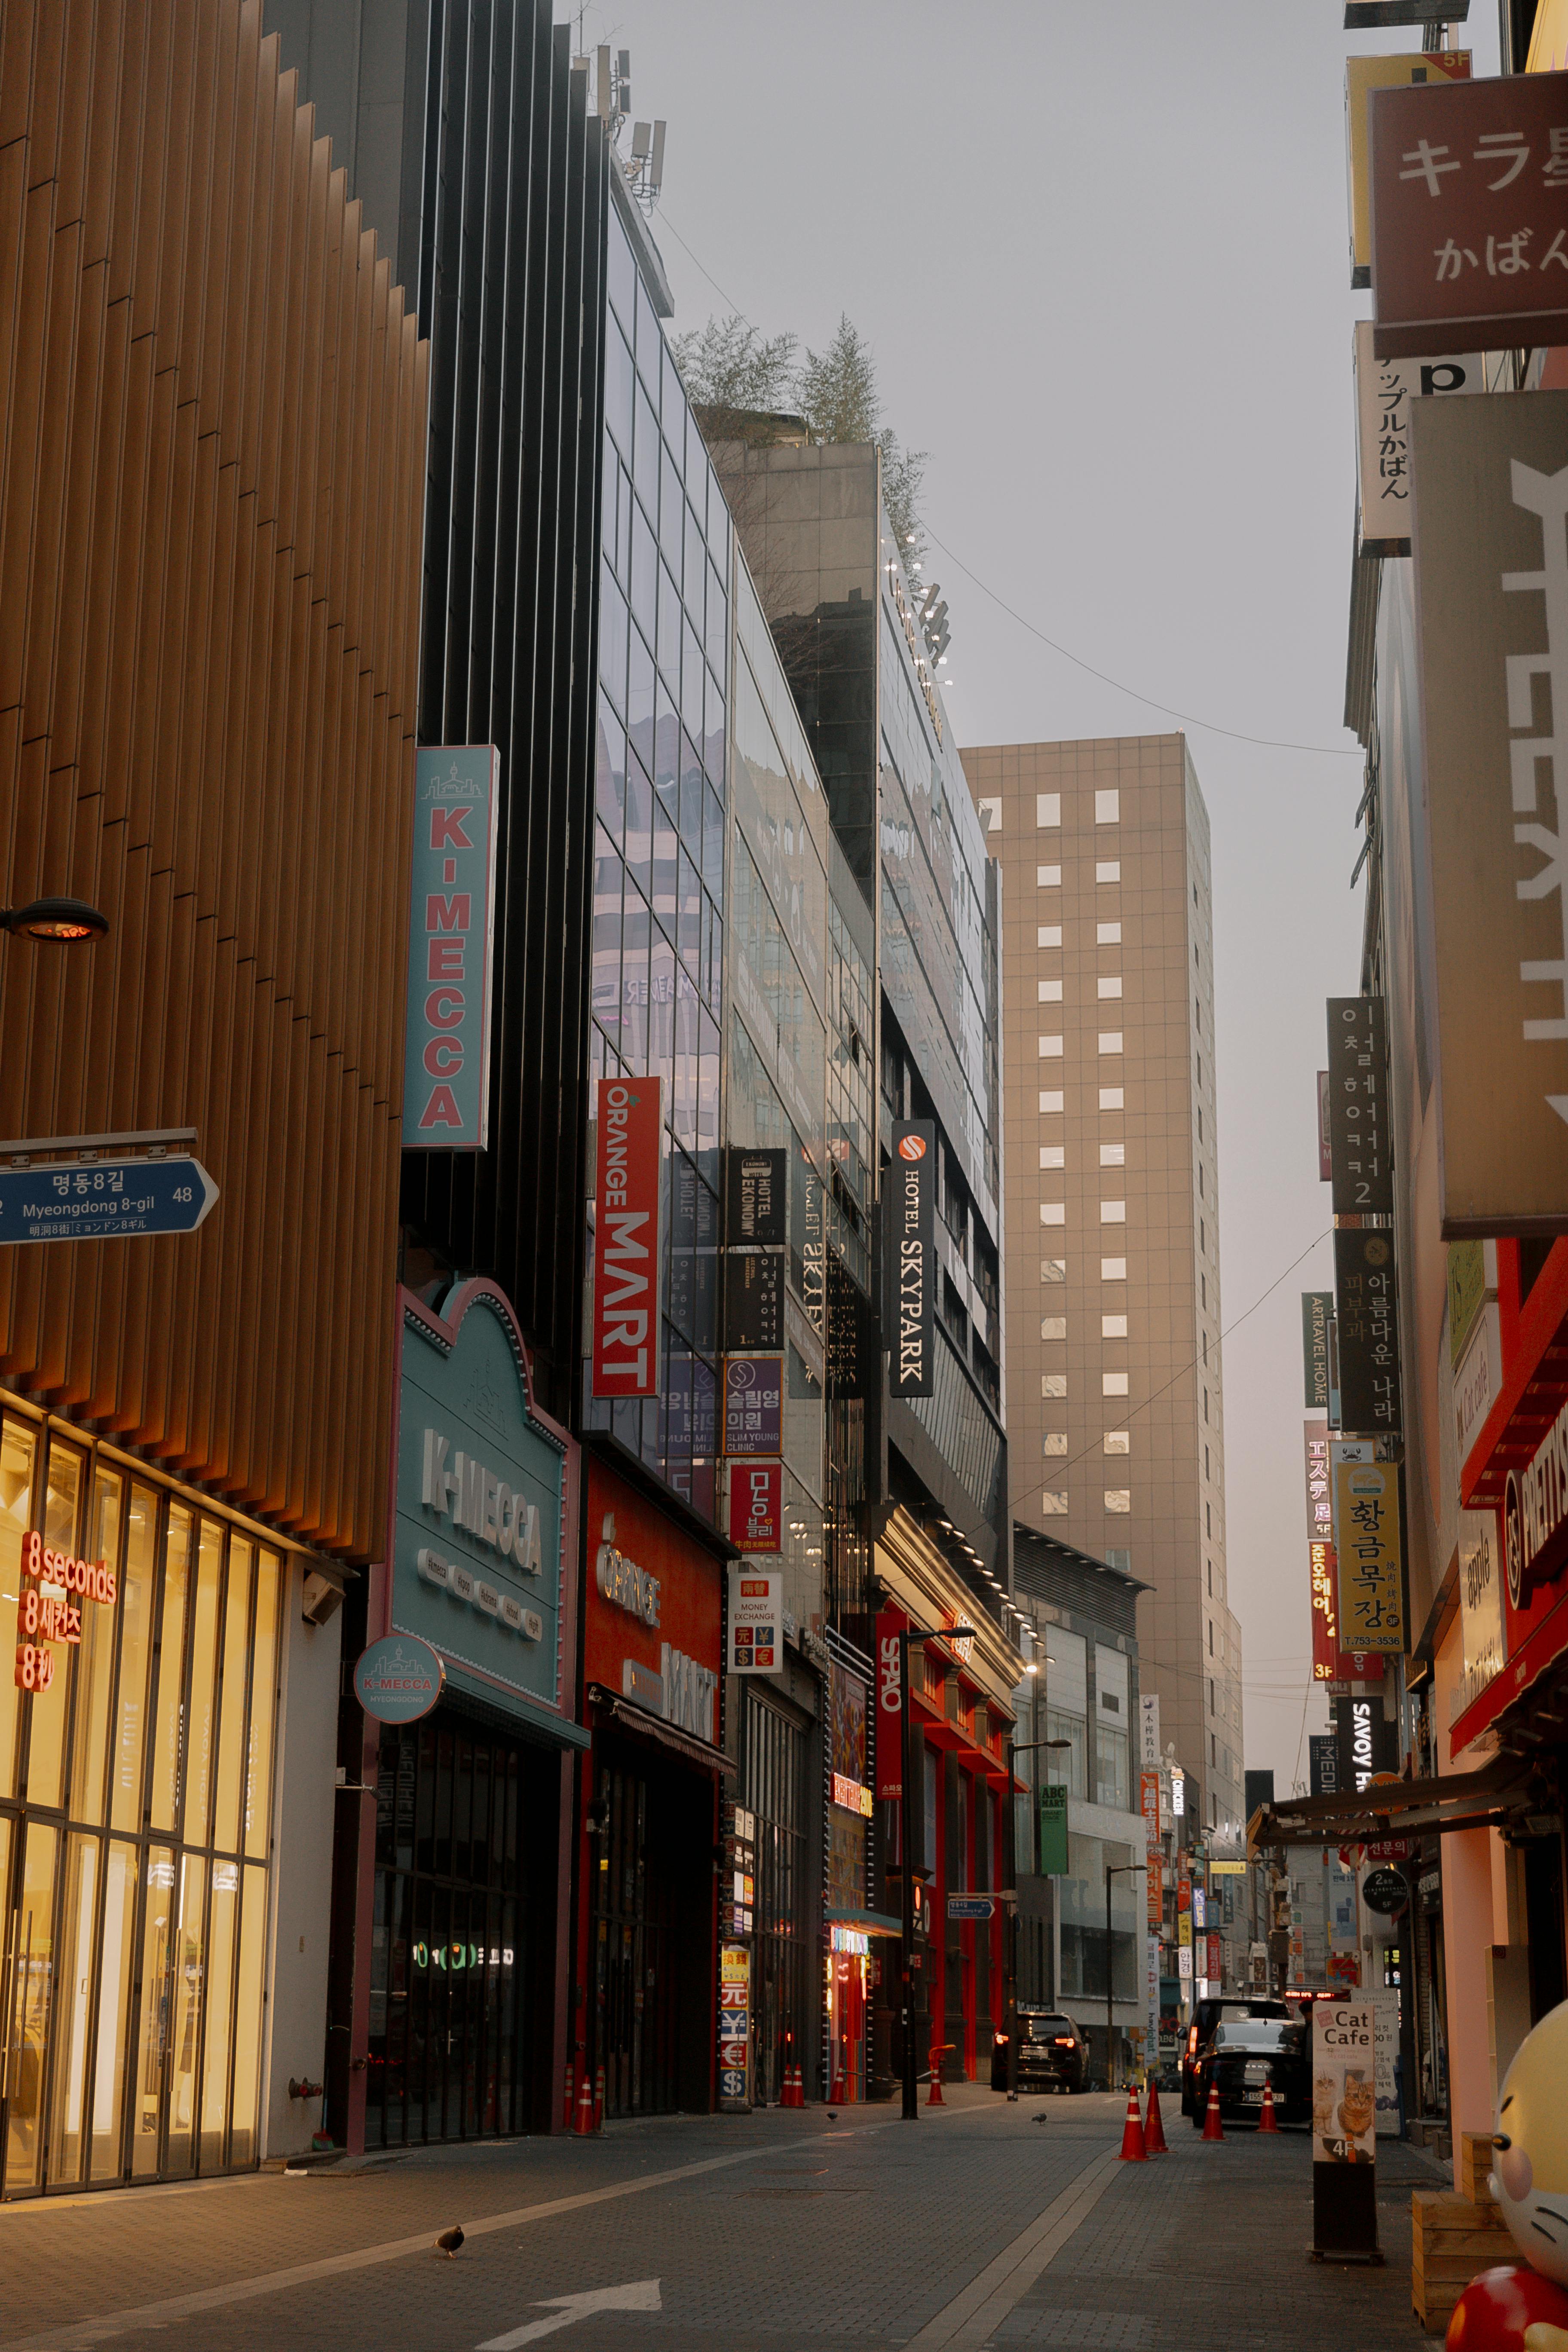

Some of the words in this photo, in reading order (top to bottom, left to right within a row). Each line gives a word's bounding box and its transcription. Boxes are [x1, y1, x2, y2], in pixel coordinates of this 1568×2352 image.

[1342, 1005, 1378, 1177] 이철헤어커커
[606, 1086, 628, 1207] ORANGE
[53, 1170, 124, 1195] 명동8길
[173, 1187, 192, 1203] 48
[758, 1179, 771, 1218] HOTEL
[1355, 1182, 1371, 1203] 2
[23, 1200, 117, 1219] Myeongdong
[122, 1196, 155, 1212] 8-gil
[742, 1179, 755, 1237] EKONOMY
[906, 1170, 919, 1234] HOTEL
[30, 1225, 70, 1237] 明洞8街
[602, 1211, 649, 1387] MART
[900, 1240, 923, 1383] SKYPARK
[1344, 1273, 1367, 1342] 피부과
[1312, 1297, 1326, 1358] ARTRAVEL
[1369, 1273, 1393, 1365] 아름다운
[727, 1390, 779, 1409] 슬림영
[1314, 1360, 1326, 1403] HOME
[1372, 1376, 1396, 1422] 나라
[727, 1412, 762, 1430] 의원
[727, 1433, 747, 1442] SLIM
[749, 1433, 779, 1441] YOUNG
[727, 1442, 755, 1452] CLINIC
[1309, 1441, 1327, 1500] エステ
[28, 1530, 41, 1575] 8
[43, 1547, 116, 1604] seconds
[428, 1556, 446, 1579] #kmecca
[1311, 1544, 1332, 1615] 준오헤어
[1350, 1499, 1387, 1628] 황금목장
[1467, 1528, 1490, 1611] apple
[1344, 1637, 1400, 1646] T.753-3536
[363, 1676, 432, 1690] K-MECCA
[881, 1637, 901, 1712] SPAO
[1315, 1663, 1333, 1678] 3F
[370, 1695, 424, 1704] MYEONGDONG
[1353, 1703, 1372, 1768] SAVOY
[1041, 1799, 1066, 1808] MART
[1042, 1787, 1065, 1798] ABC
[1172, 1779, 1184, 1816] CHICKEN
[1324, 2028, 1370, 2046] Cafe
[1335, 2011, 1369, 2027] Cat
[1332, 2141, 1355, 2156] 4F
